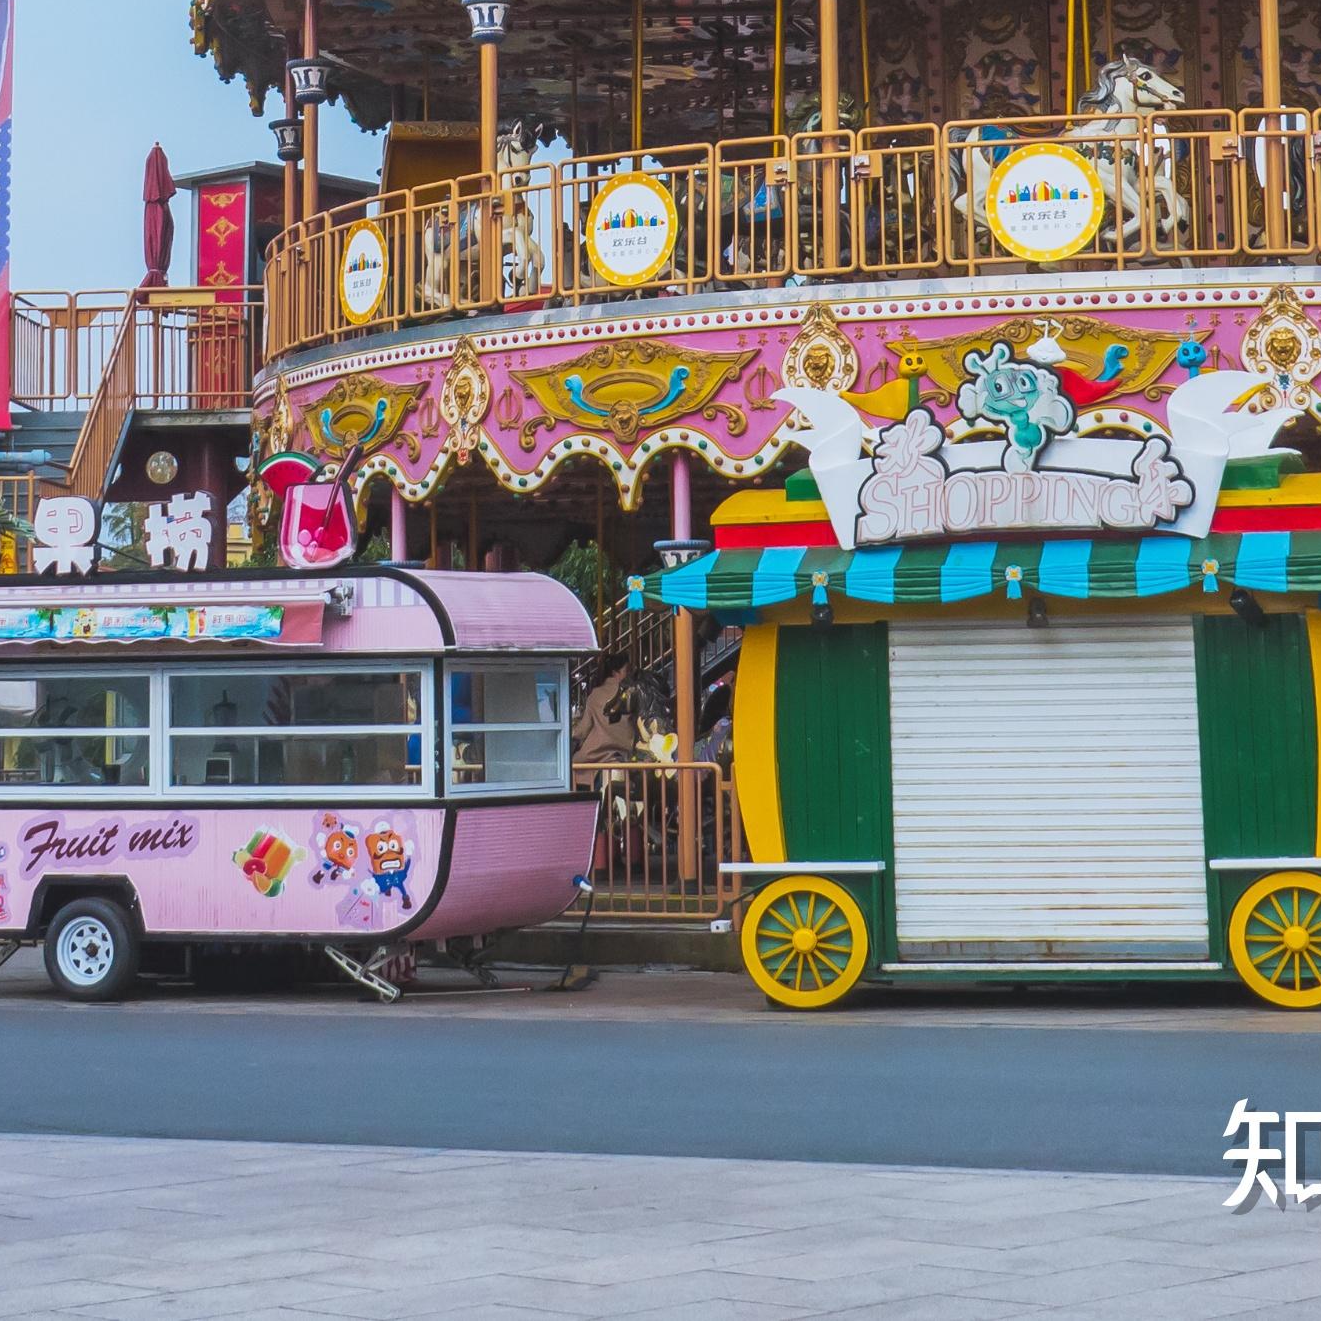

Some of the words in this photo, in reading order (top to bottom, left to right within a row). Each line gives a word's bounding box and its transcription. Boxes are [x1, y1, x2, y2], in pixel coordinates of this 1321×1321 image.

[860, 475, 1140, 542] SHOPPING
[24, 820, 118, 872] Fruit
[129, 820, 193, 852] mix
